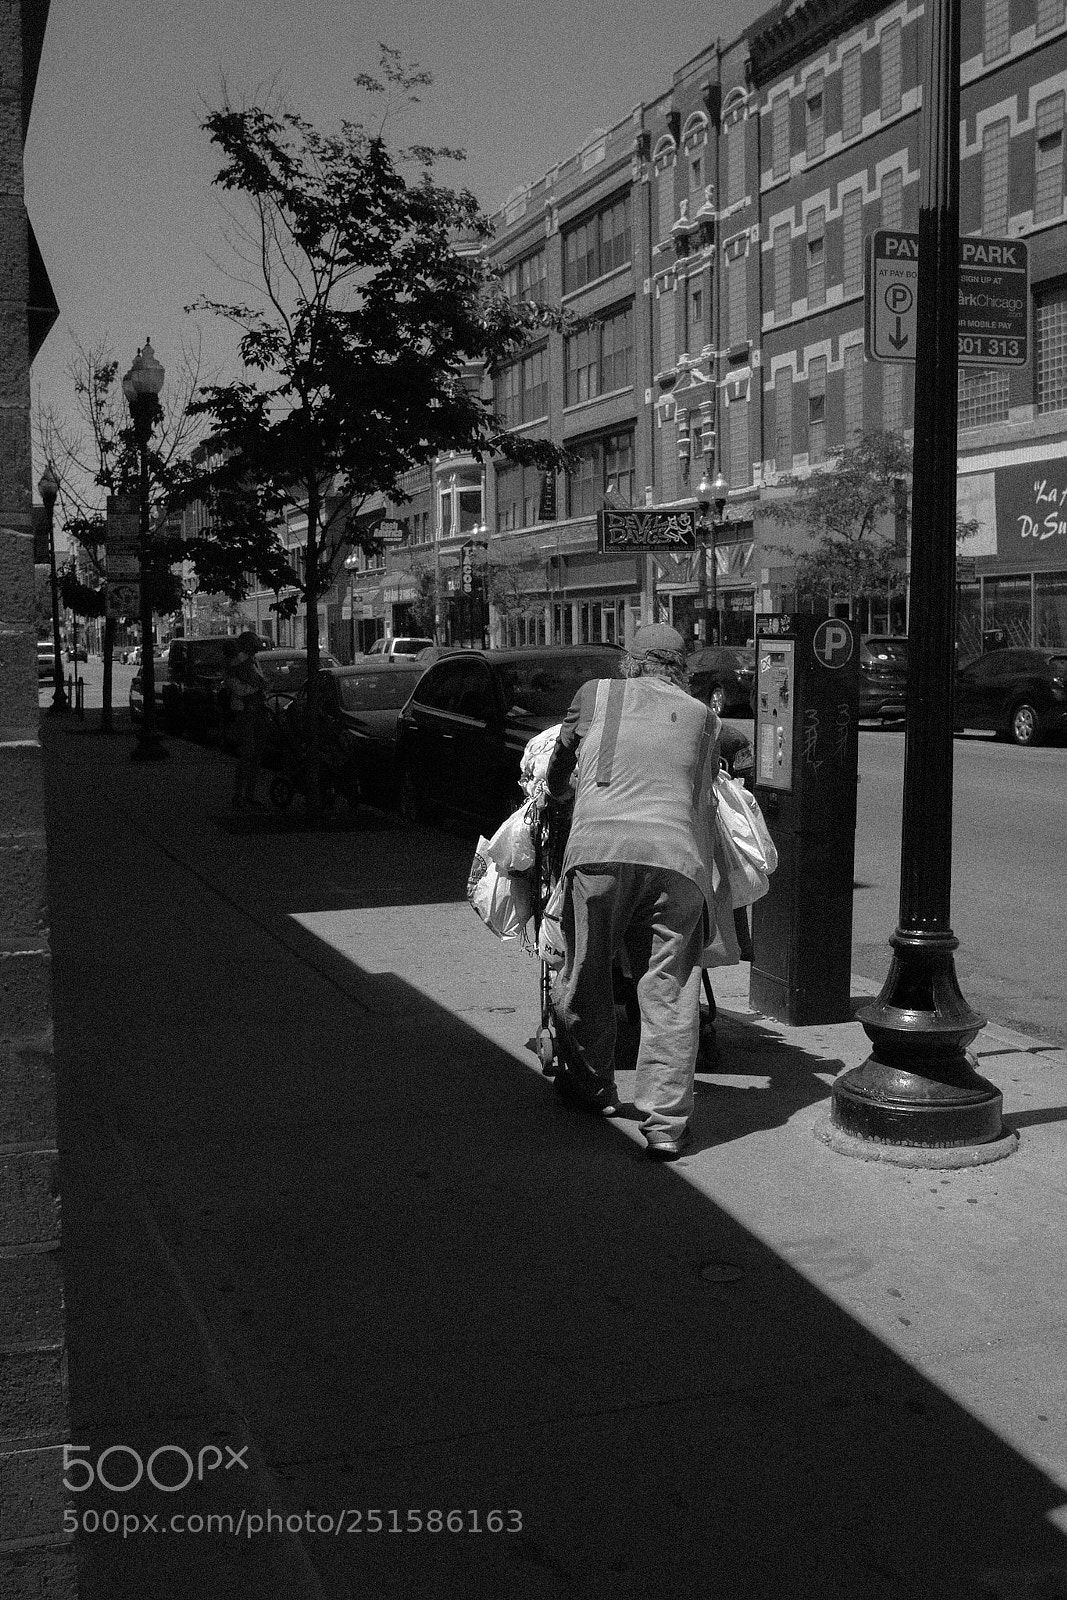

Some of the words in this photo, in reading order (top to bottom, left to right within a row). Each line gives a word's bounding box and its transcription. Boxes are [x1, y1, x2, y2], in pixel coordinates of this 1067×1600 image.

[886, 237, 918, 257] PAY
[963, 244, 1017, 264] PARK
[890, 270, 904, 278] PAY
[961, 275, 979, 283] SIGN
[980, 276, 991, 284] UP
[993, 277, 1002, 285] AT
[892, 288, 907, 308] P
[959, 293, 1023, 312] arkChicago
[968, 320, 997, 329] MOBILE
[998, 322, 1012, 330] PAY
[988, 339, 1019, 356] 313
[463, 546, 472, 593] TACOS
[824, 627, 847, 659] P
